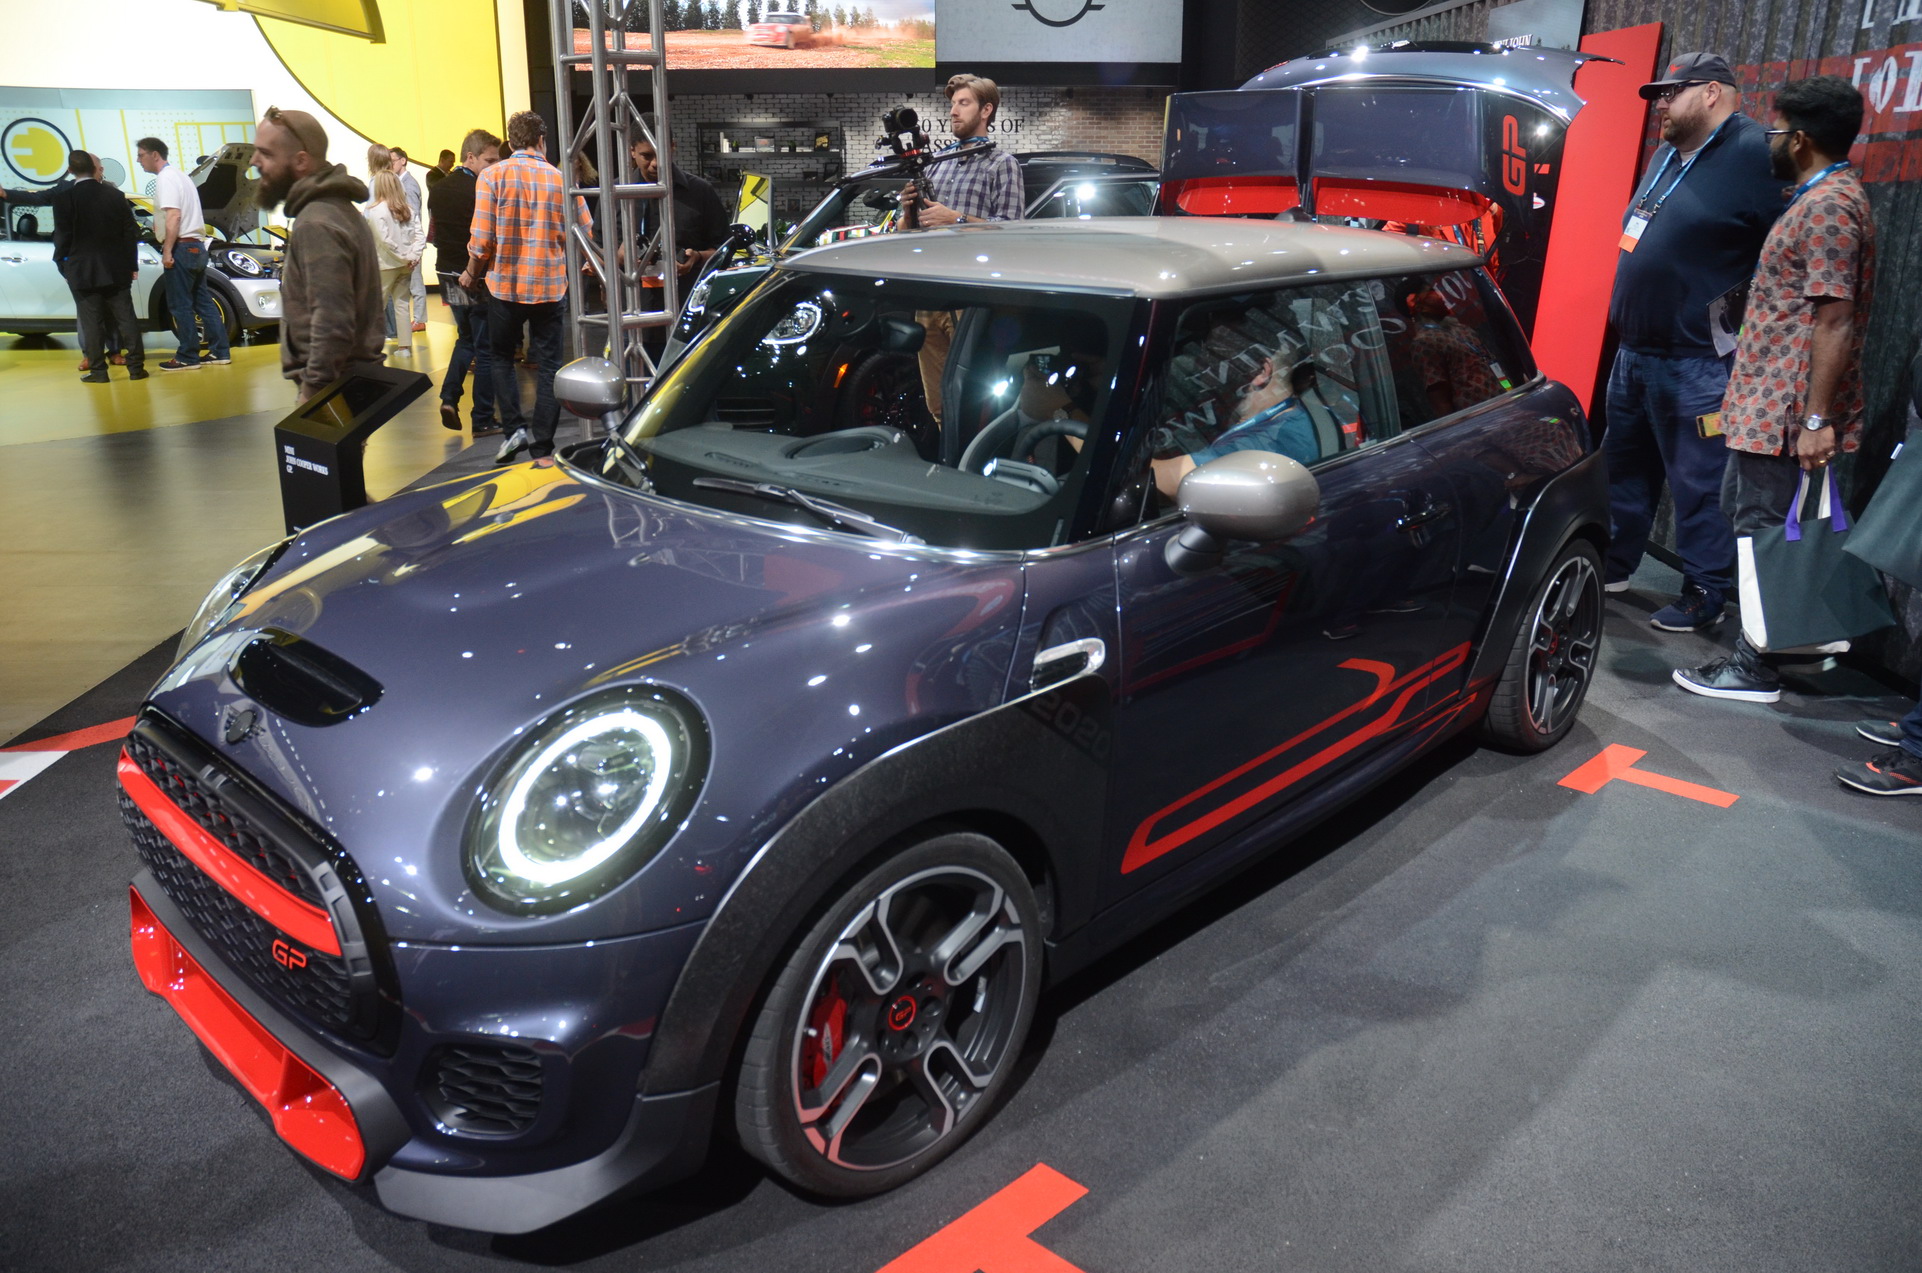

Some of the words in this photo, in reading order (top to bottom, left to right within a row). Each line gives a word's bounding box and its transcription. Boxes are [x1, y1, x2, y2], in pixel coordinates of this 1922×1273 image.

[1001, 118, 1025, 133] OF
[1503, 114, 1527, 196] GP
[272, 939, 307, 970] GP
